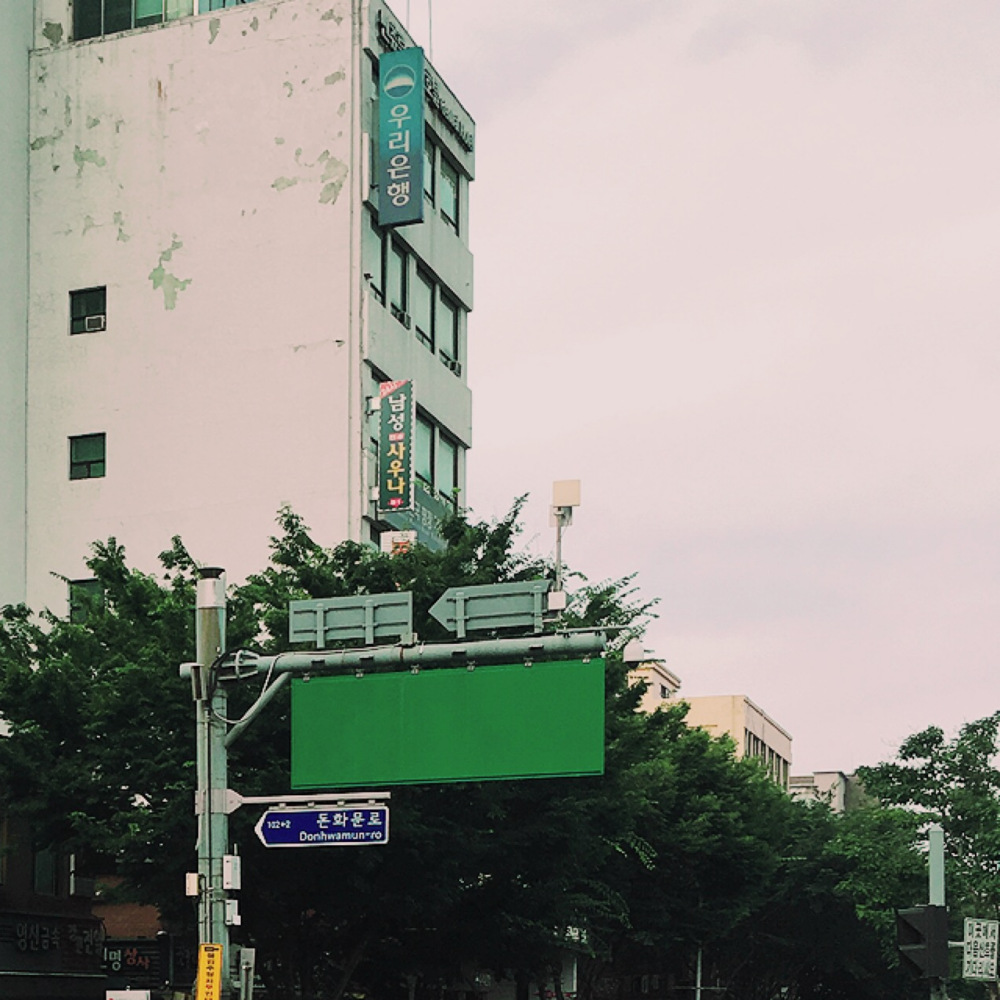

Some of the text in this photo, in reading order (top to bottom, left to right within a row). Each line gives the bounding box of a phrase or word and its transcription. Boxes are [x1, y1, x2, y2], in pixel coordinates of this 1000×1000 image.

[387, 104, 412, 206] 우리은행
[387, 394, 407, 431] 남성
[386, 442, 406, 494] 사우나
[300, 830, 382, 842] Donhwamun-ro
[316, 811, 383, 829] 돈화문로
